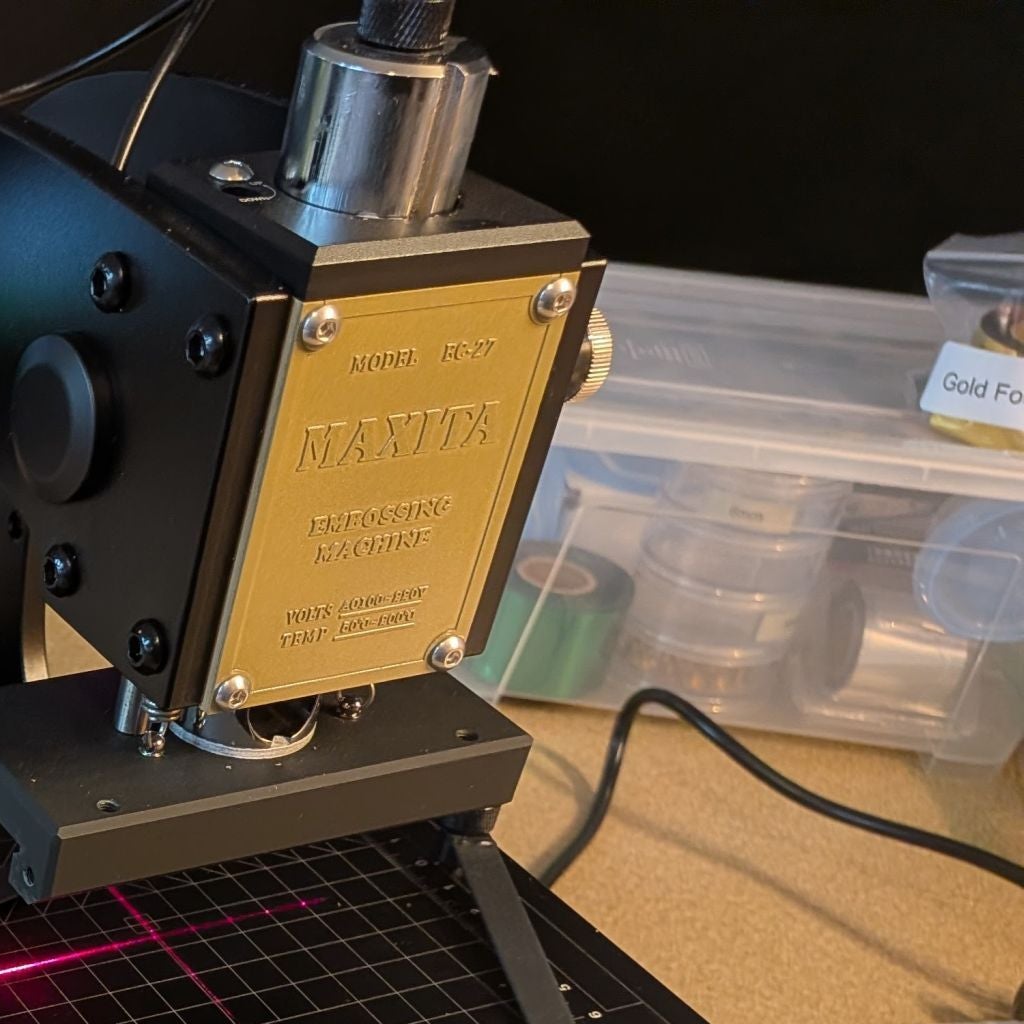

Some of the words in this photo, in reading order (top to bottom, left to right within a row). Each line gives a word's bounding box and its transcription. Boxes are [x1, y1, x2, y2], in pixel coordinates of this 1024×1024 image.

[349, 348, 418, 375] MODEL
[943, 371, 988, 399] Gold
[994, 382, 1024, 405] Fo
[295, 400, 501, 473] MAXITA
[308, 495, 453, 538] EMBOSSING
[314, 526, 433, 565] MACHINE
[286, 603, 334, 625] VOLTS
[280, 627, 328, 648] TEMP
